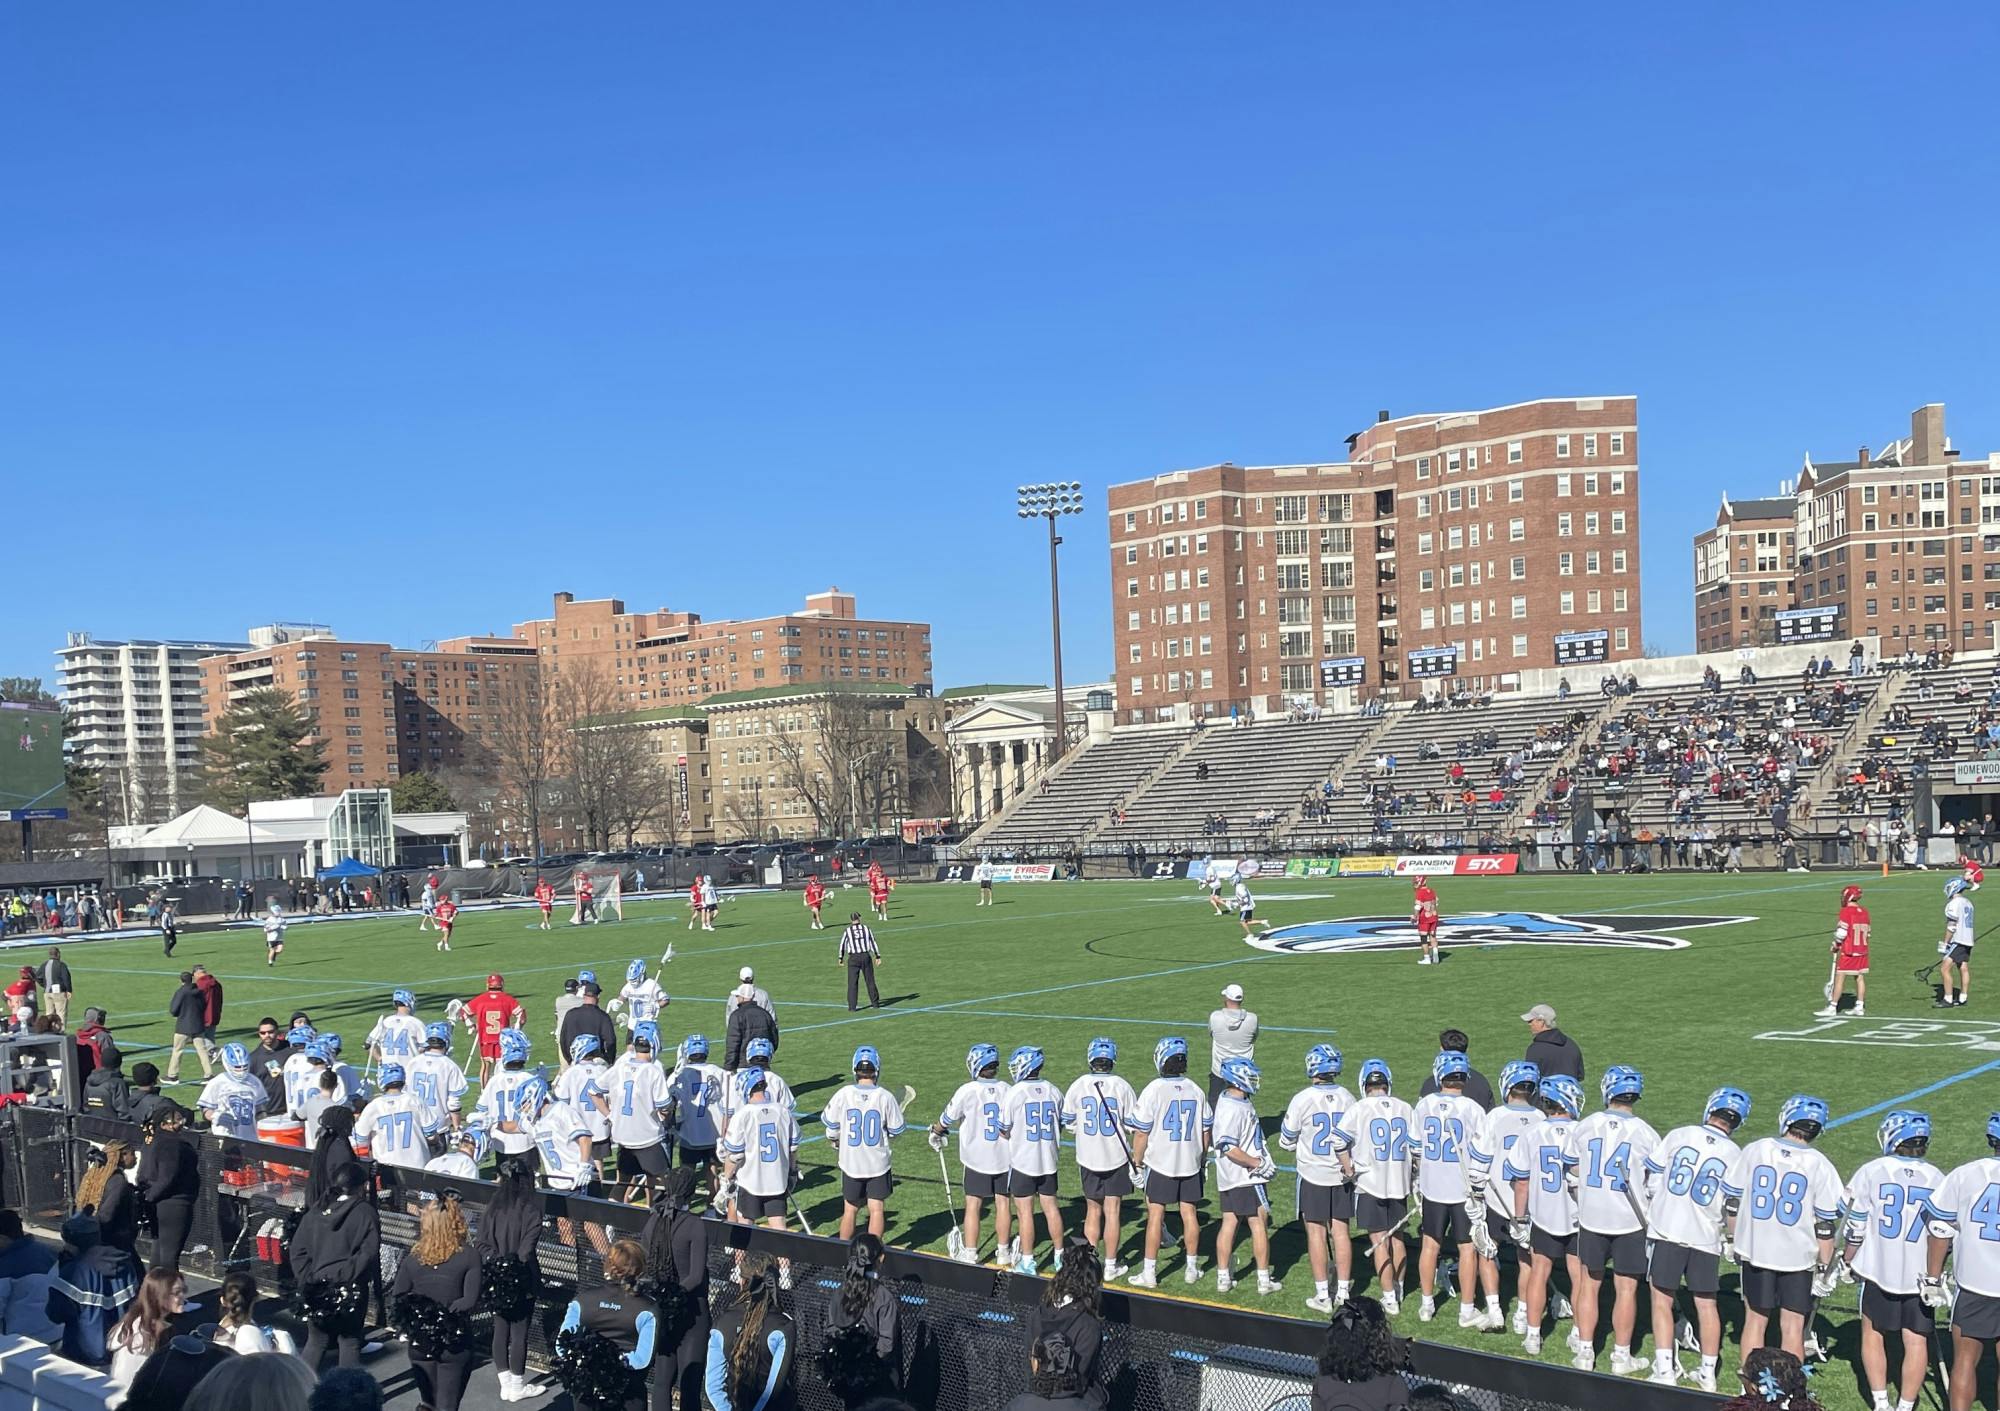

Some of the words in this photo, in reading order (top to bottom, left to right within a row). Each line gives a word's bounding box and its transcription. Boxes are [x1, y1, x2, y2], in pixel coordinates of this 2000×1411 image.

[1408, 859, 1454, 867] PANSINI
[1466, 858, 1504, 871] STX
[383, 1028, 409, 1056] 44
[485, 1010, 501, 1034] 5
[413, 1071, 437, 1107] 51
[621, 1079, 634, 1116] 1
[377, 1110, 413, 1152] 77
[846, 1108, 882, 1147] 30
[1024, 1101, 1057, 1142] 55
[1081, 1095, 1118, 1137] 36
[1162, 1099, 1198, 1142] 47
[759, 1122, 779, 1163] 5
[1369, 1116, 1408, 1162] 92
[1423, 1115, 1464, 1163] 32
[1586, 1137, 1632, 1193] 14
[1666, 1145, 1728, 1207] 66
[1751, 1164, 1808, 1227] 88
[1878, 1182, 1935, 1243] 37
